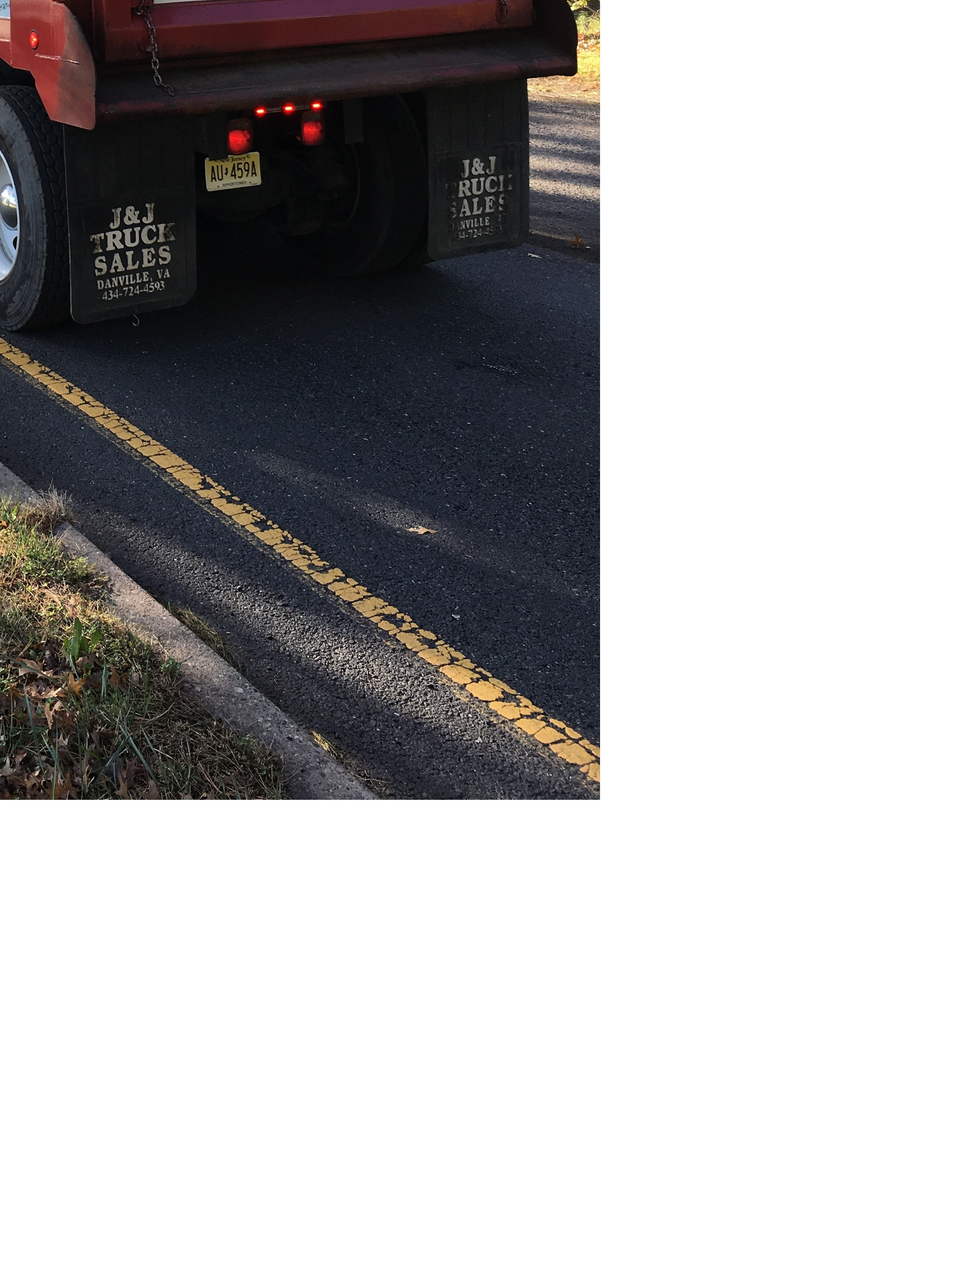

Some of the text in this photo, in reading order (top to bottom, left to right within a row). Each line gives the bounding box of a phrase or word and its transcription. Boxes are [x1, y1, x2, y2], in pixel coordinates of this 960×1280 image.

[461, 156, 497, 179] J&J
[445, 174, 513, 198] RUCK
[109, 203, 155, 230] J&J
[90, 222, 176, 254] TRUCK
[94, 245, 172, 277] SALES
[97, 268, 171, 290] DANVILLE, VA
[102, 280, 166, 301] 434-724-4593
